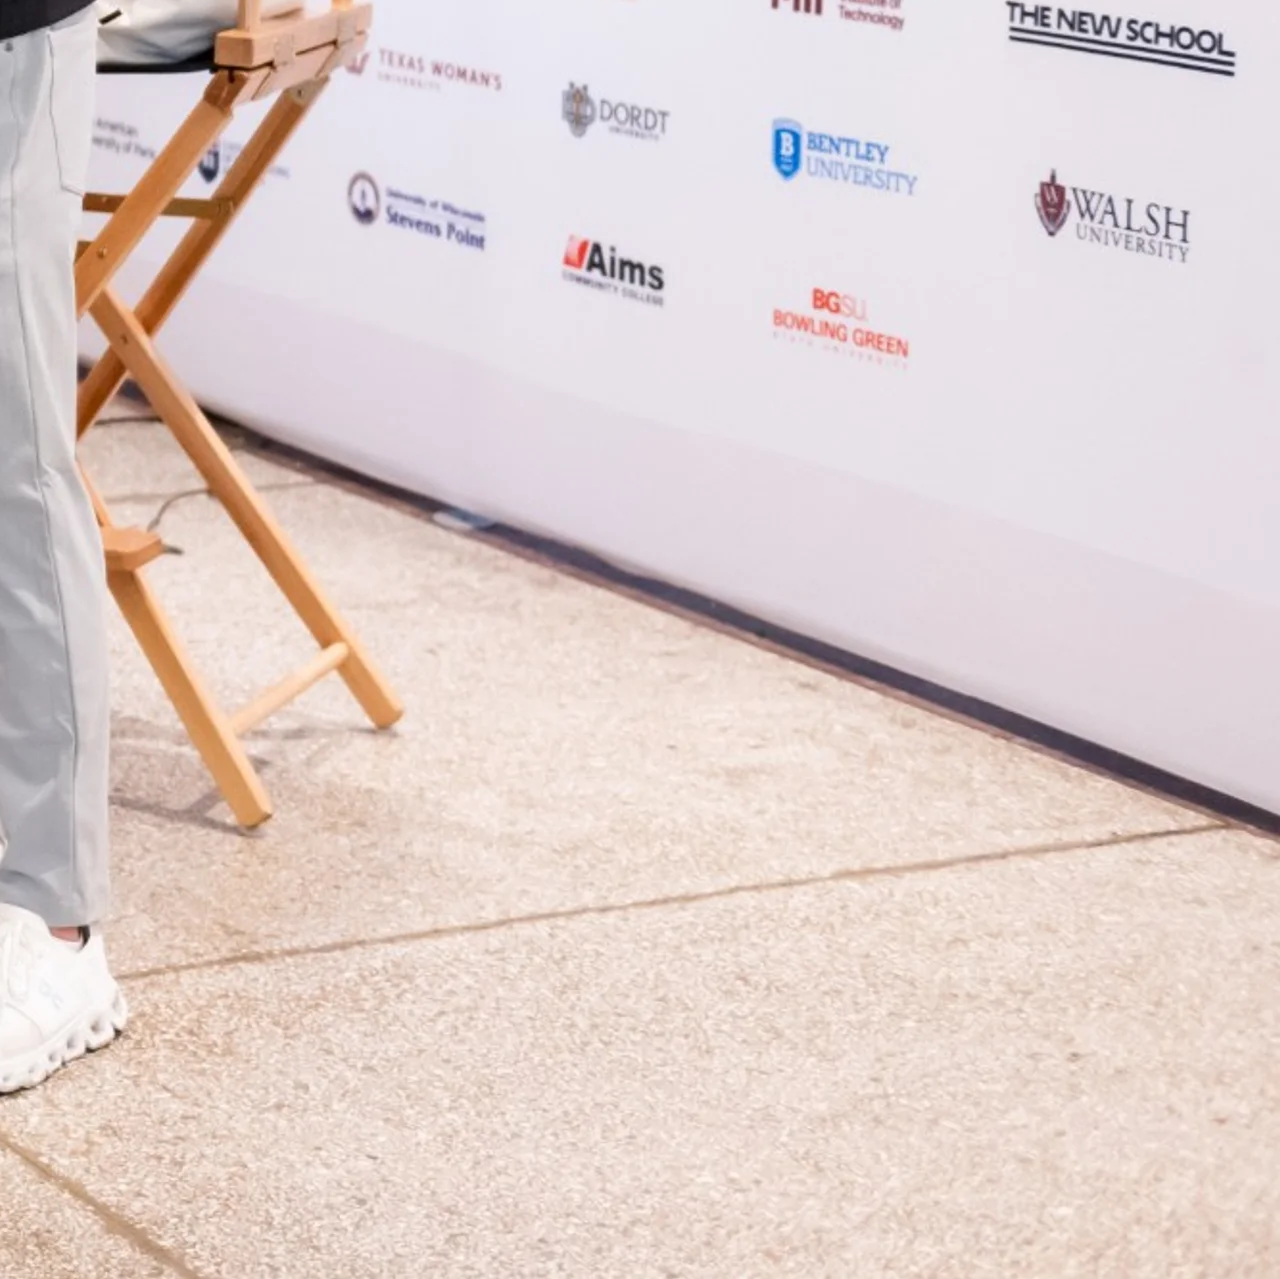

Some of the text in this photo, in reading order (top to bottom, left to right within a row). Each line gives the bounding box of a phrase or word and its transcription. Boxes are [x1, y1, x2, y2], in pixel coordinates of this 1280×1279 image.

[837, 4, 906, 32] Technology
[1005, 0, 1237, 58] THE NEW SCHOOL
[378, 47, 503, 92] TEXAS WOMAN'S
[600, 98, 671, 134] DORDT
[806, 130, 890, 165] BENTLEY
[806, 155, 918, 196] UNIVERSITY
[385, 204, 486, 252] Stevens Point
[1070, 186, 1191, 244] WALSH
[1076, 222, 1190, 264] UNIVERSITY
[586, 241, 666, 292] Aims
[561, 270, 665, 308] COMMUNITY COLLEGE
[811, 287, 868, 321] BGSU
[772, 308, 910, 359] BOWLING GREEN
